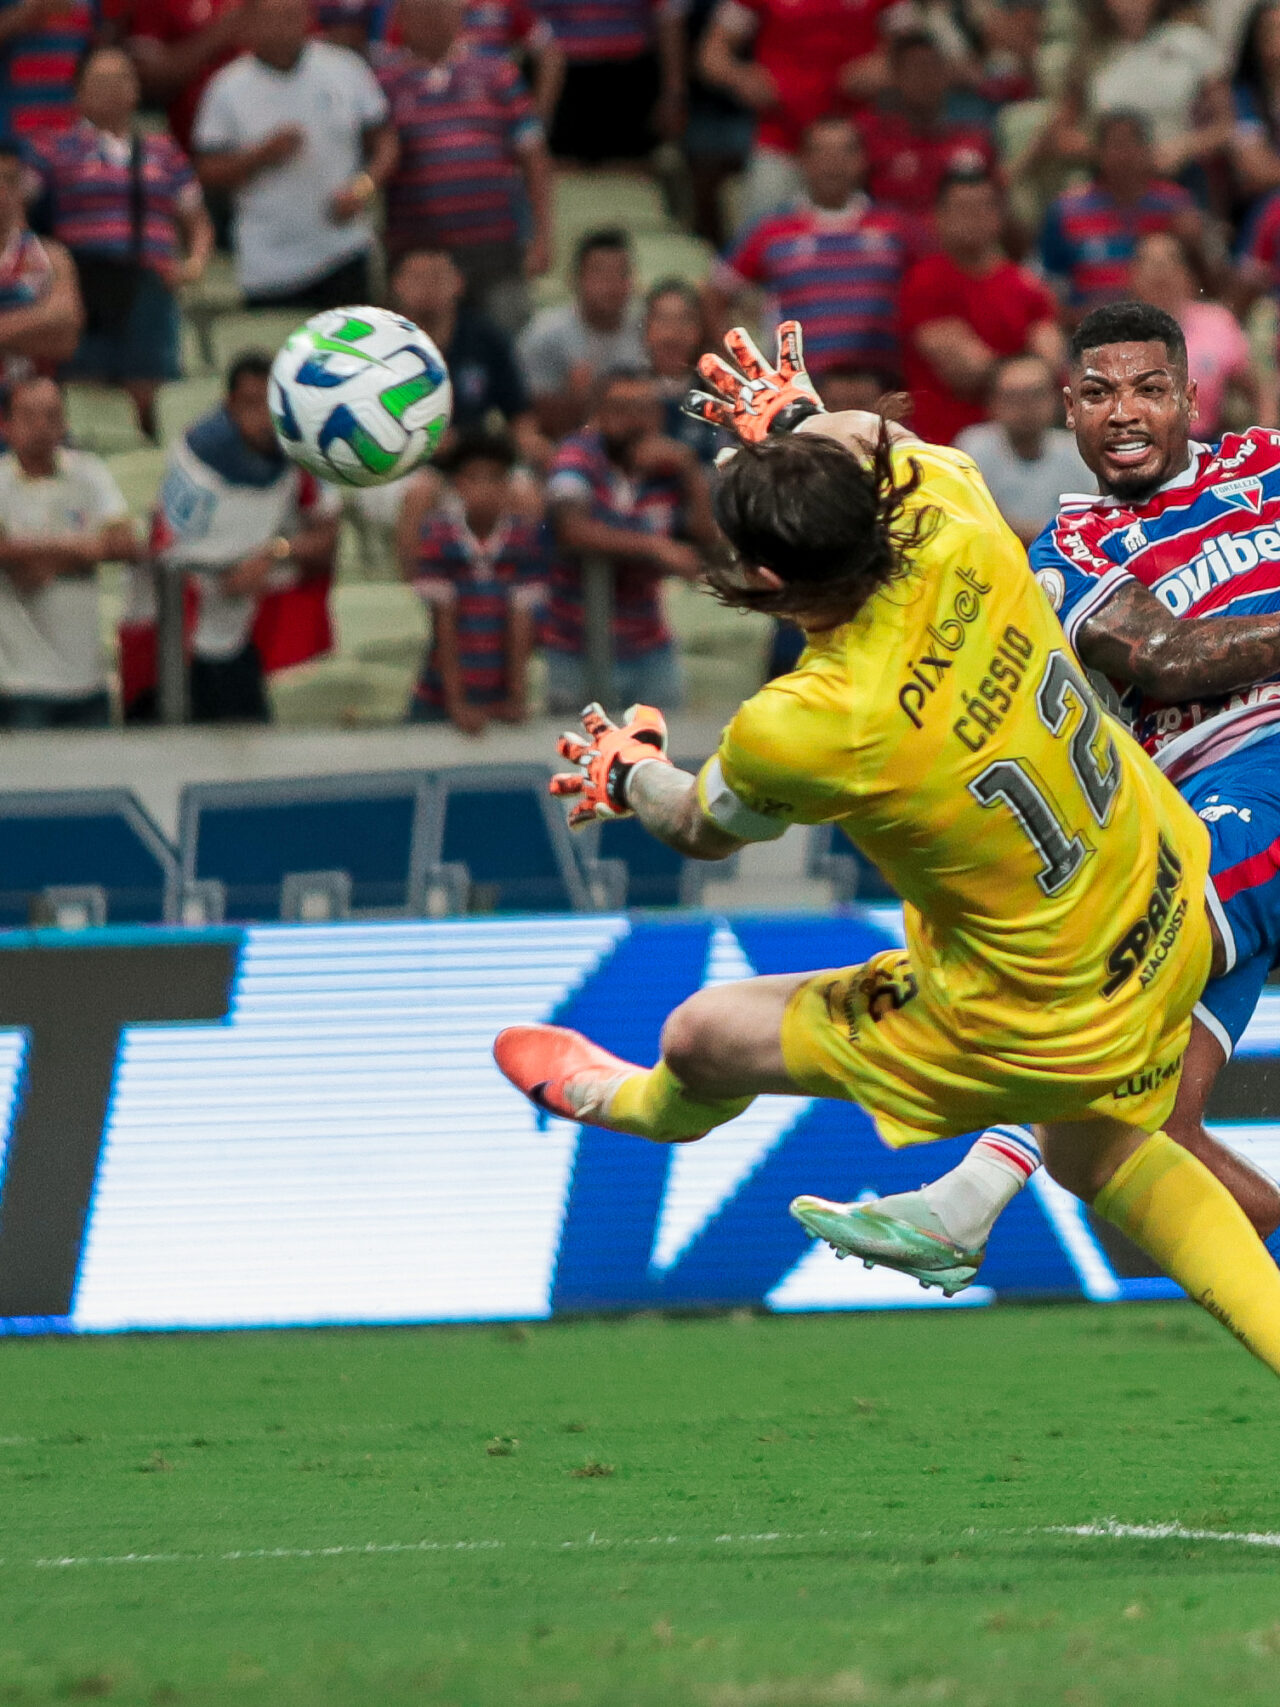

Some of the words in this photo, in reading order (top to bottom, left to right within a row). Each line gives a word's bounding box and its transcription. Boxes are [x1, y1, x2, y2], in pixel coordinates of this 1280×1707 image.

[898, 566, 992, 730] pixbet
[952, 624, 1034, 753] CÁSSIO
[965, 648, 1123, 899] 12
[1138, 897, 1190, 991] ATACADISTA
